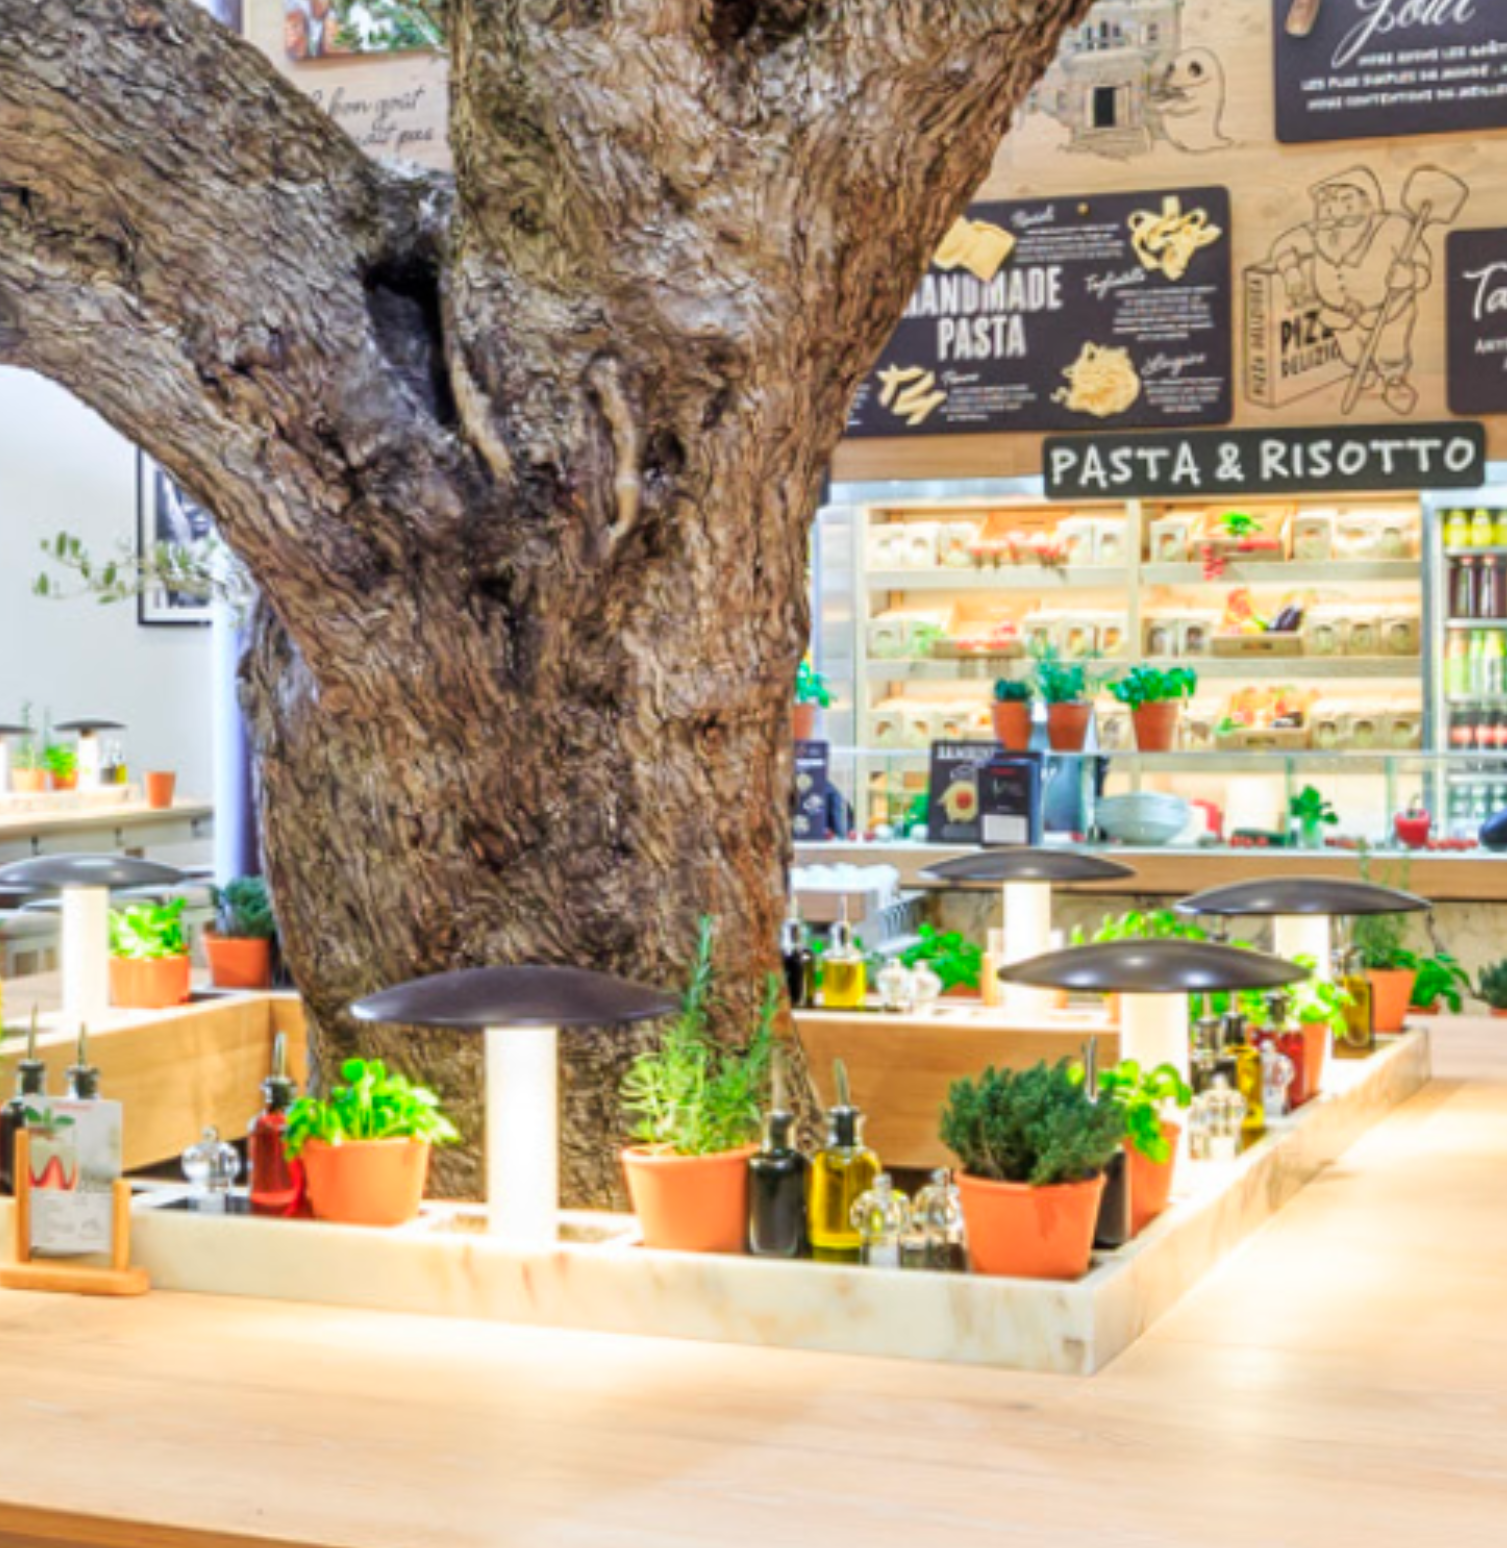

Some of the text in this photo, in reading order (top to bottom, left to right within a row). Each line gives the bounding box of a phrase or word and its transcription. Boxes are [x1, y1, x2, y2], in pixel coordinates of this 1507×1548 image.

[901, 265, 1062, 318] ANDMADE
[937, 314, 1027, 361] PASTA
[1051, 437, 1475, 488] PASTA & RISOTTO
